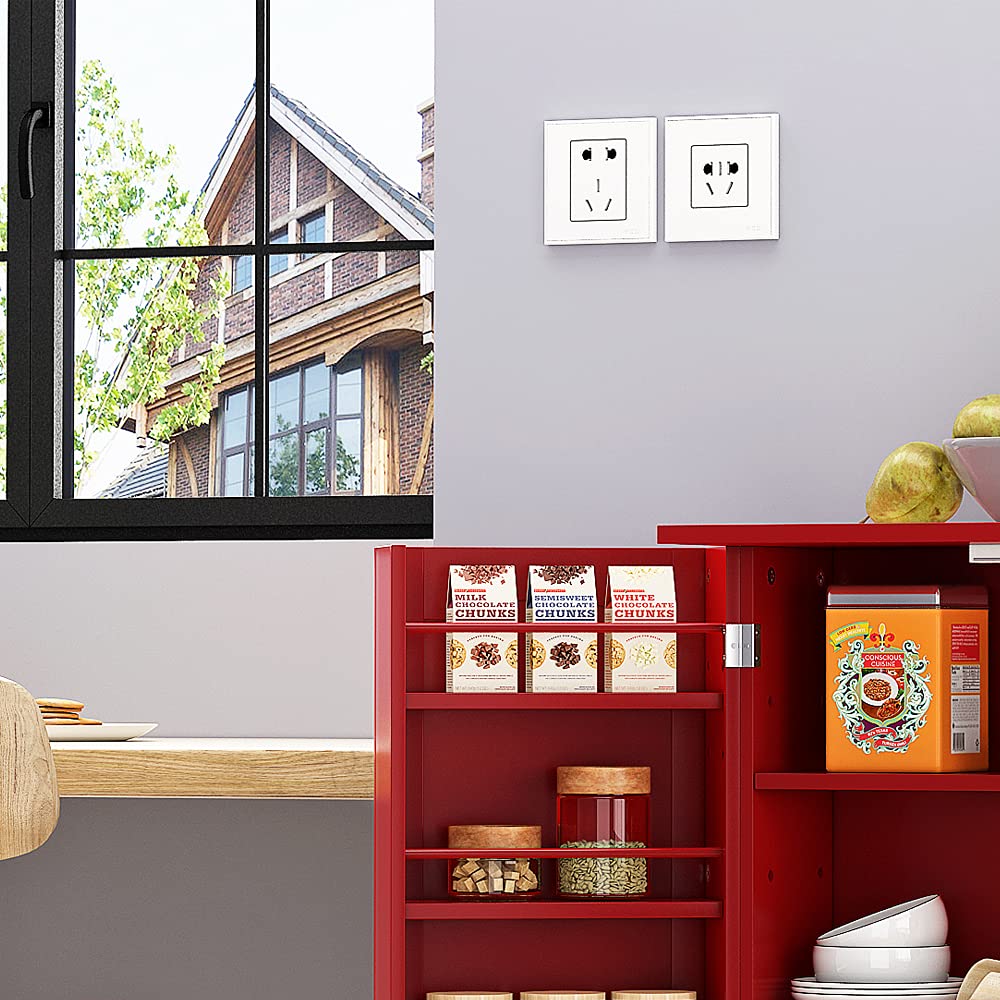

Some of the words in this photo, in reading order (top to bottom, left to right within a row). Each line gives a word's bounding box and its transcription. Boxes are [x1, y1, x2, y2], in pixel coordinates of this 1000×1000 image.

[455, 594, 486, 602] MILK
[534, 594, 594, 602] SEMISWEET
[613, 594, 655, 602] WHITE
[455, 609, 516, 618] CHUNKS
[534, 609, 596, 618] CHUNKS
[614, 609, 675, 618] CHUNKS
[864, 653, 902, 661] CONSCIOUS
